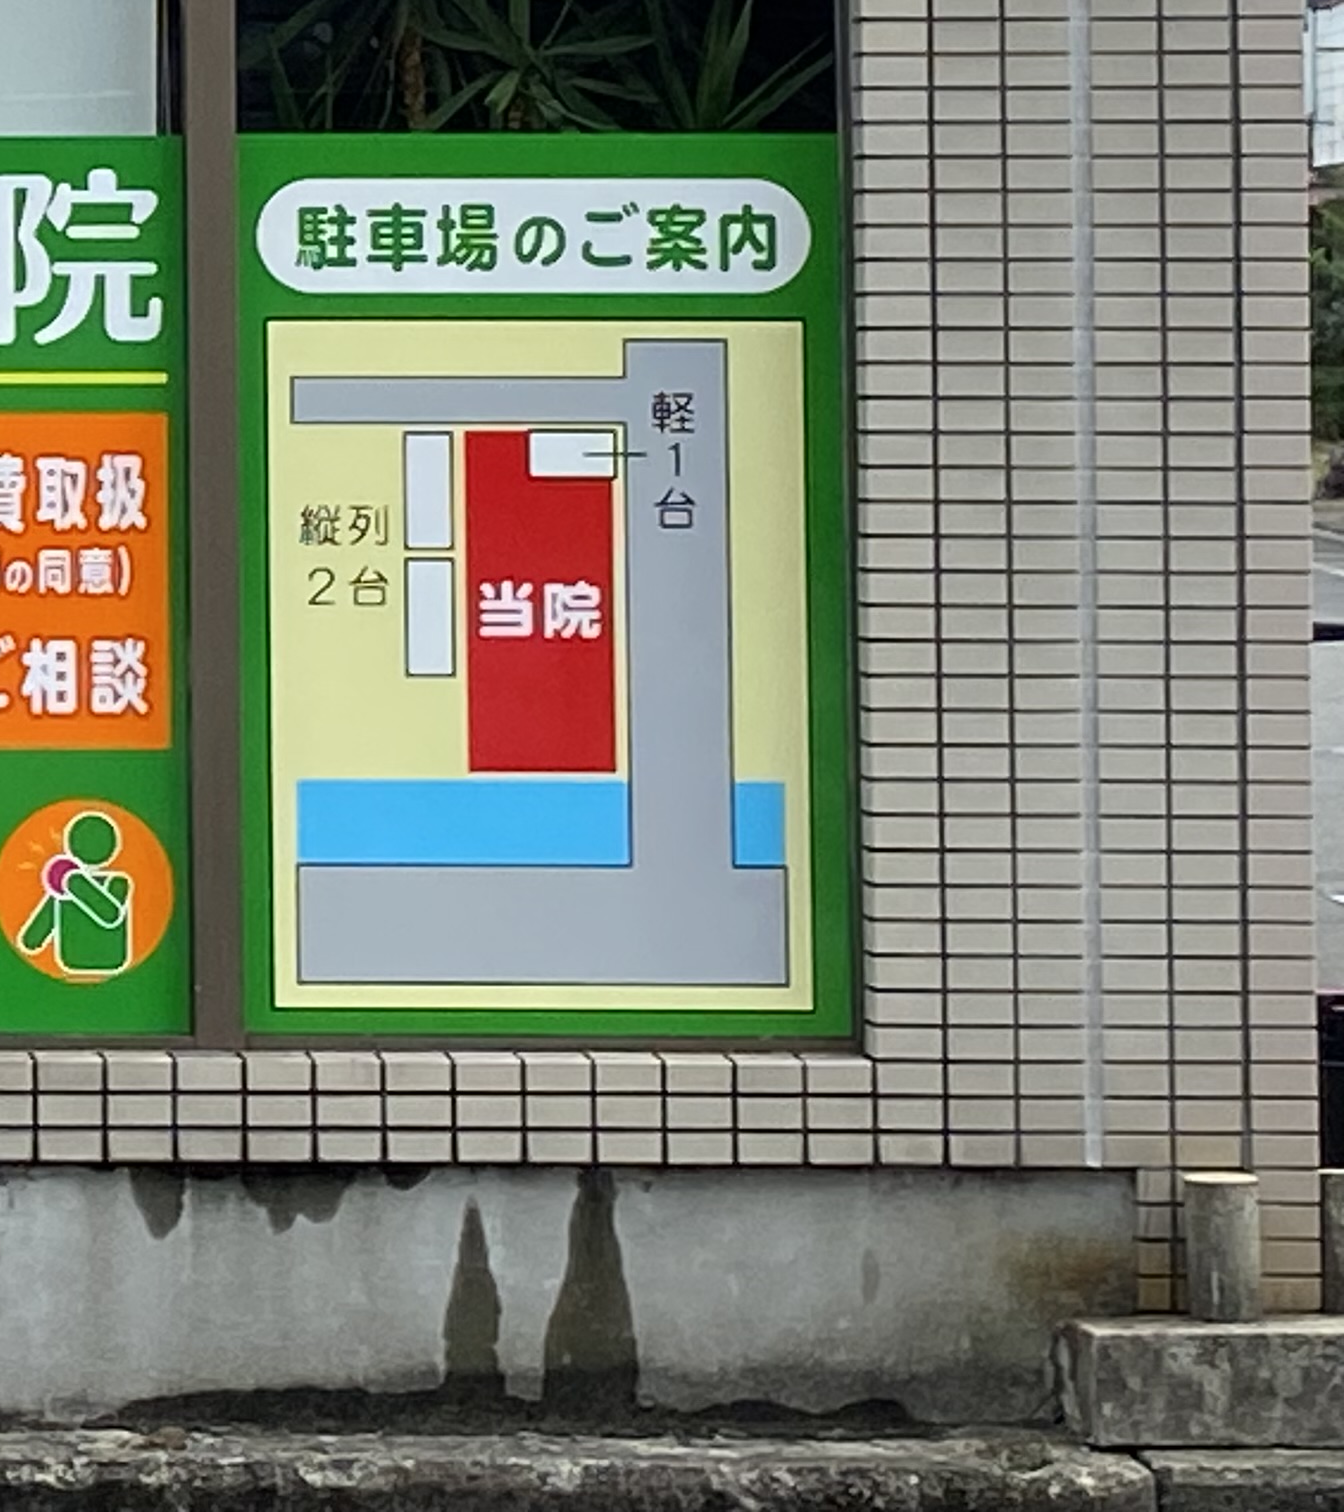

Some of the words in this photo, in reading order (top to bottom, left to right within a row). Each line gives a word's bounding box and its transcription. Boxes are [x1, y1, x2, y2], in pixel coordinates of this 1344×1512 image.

[296, 201, 779, 275] 駐車場のご案内
[307, 565, 390, 607] 2台
[479, 580, 603, 641] 当院
